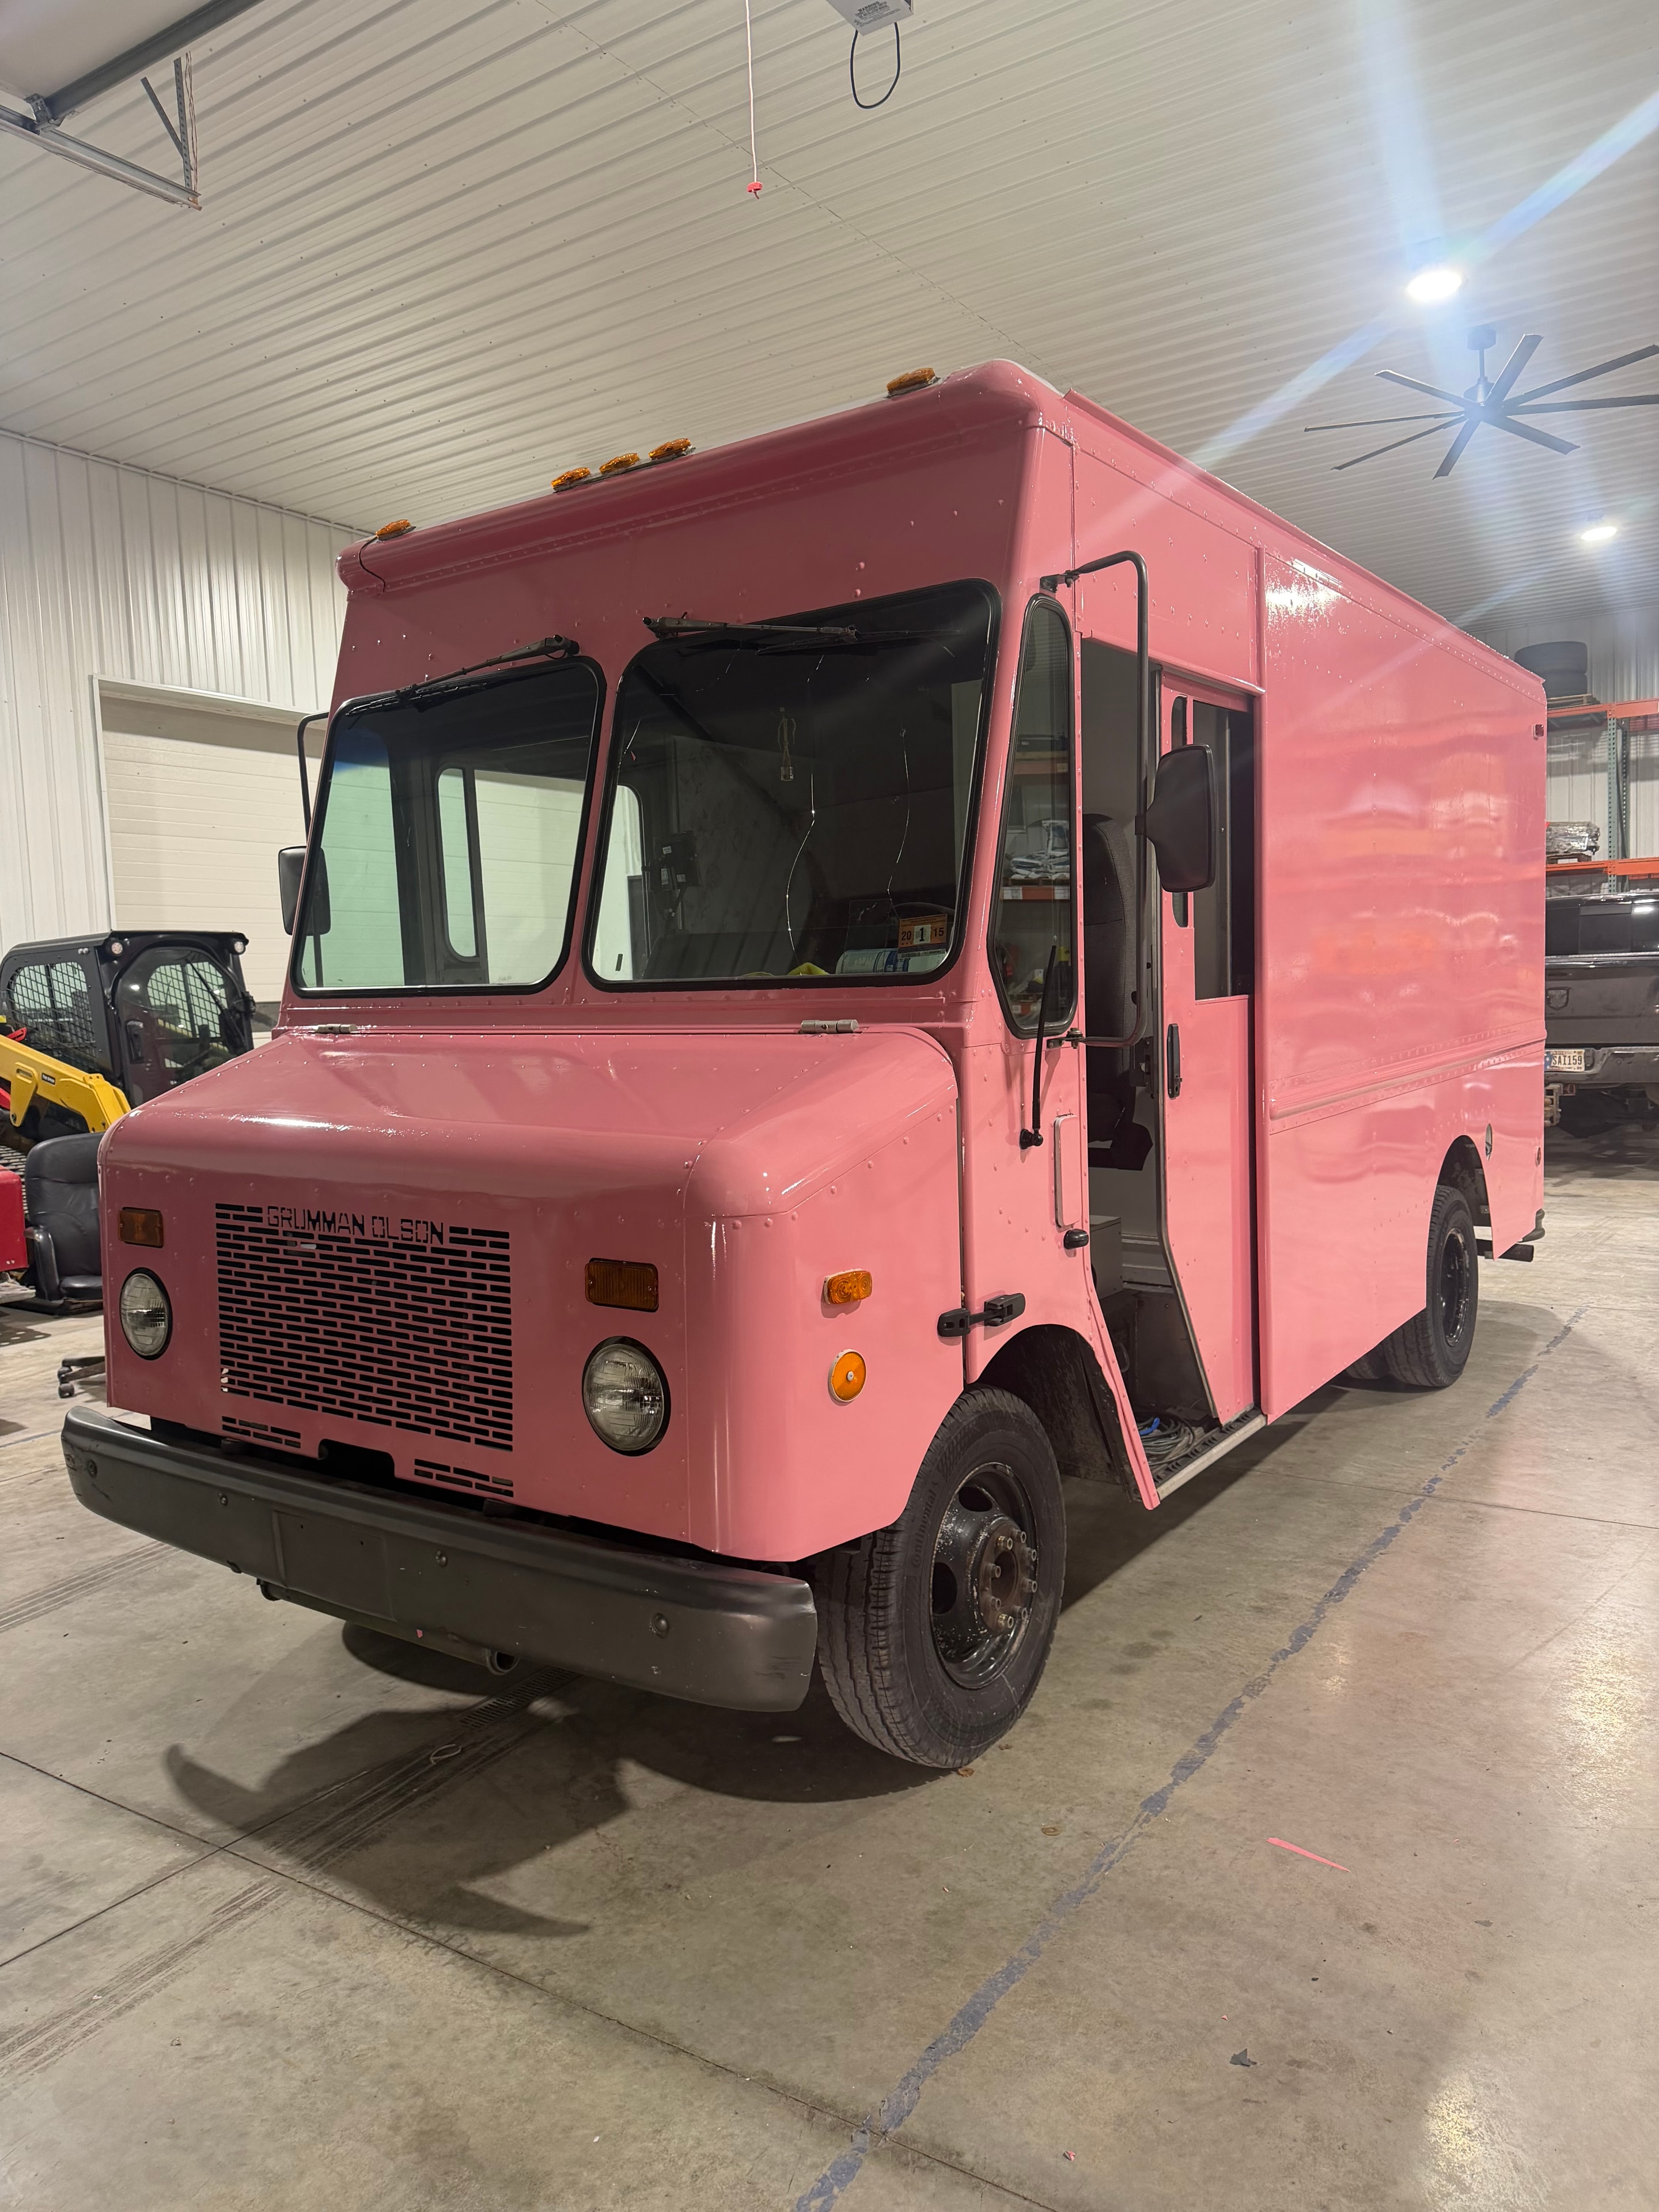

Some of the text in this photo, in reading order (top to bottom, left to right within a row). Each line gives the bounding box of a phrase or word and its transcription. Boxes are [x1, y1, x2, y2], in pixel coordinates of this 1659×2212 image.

[902, 927, 944, 942] 20 1 15
[1552, 1055, 1582, 1066] SAI159
[267, 1206, 443, 1245] GRUMMAN OLSON
